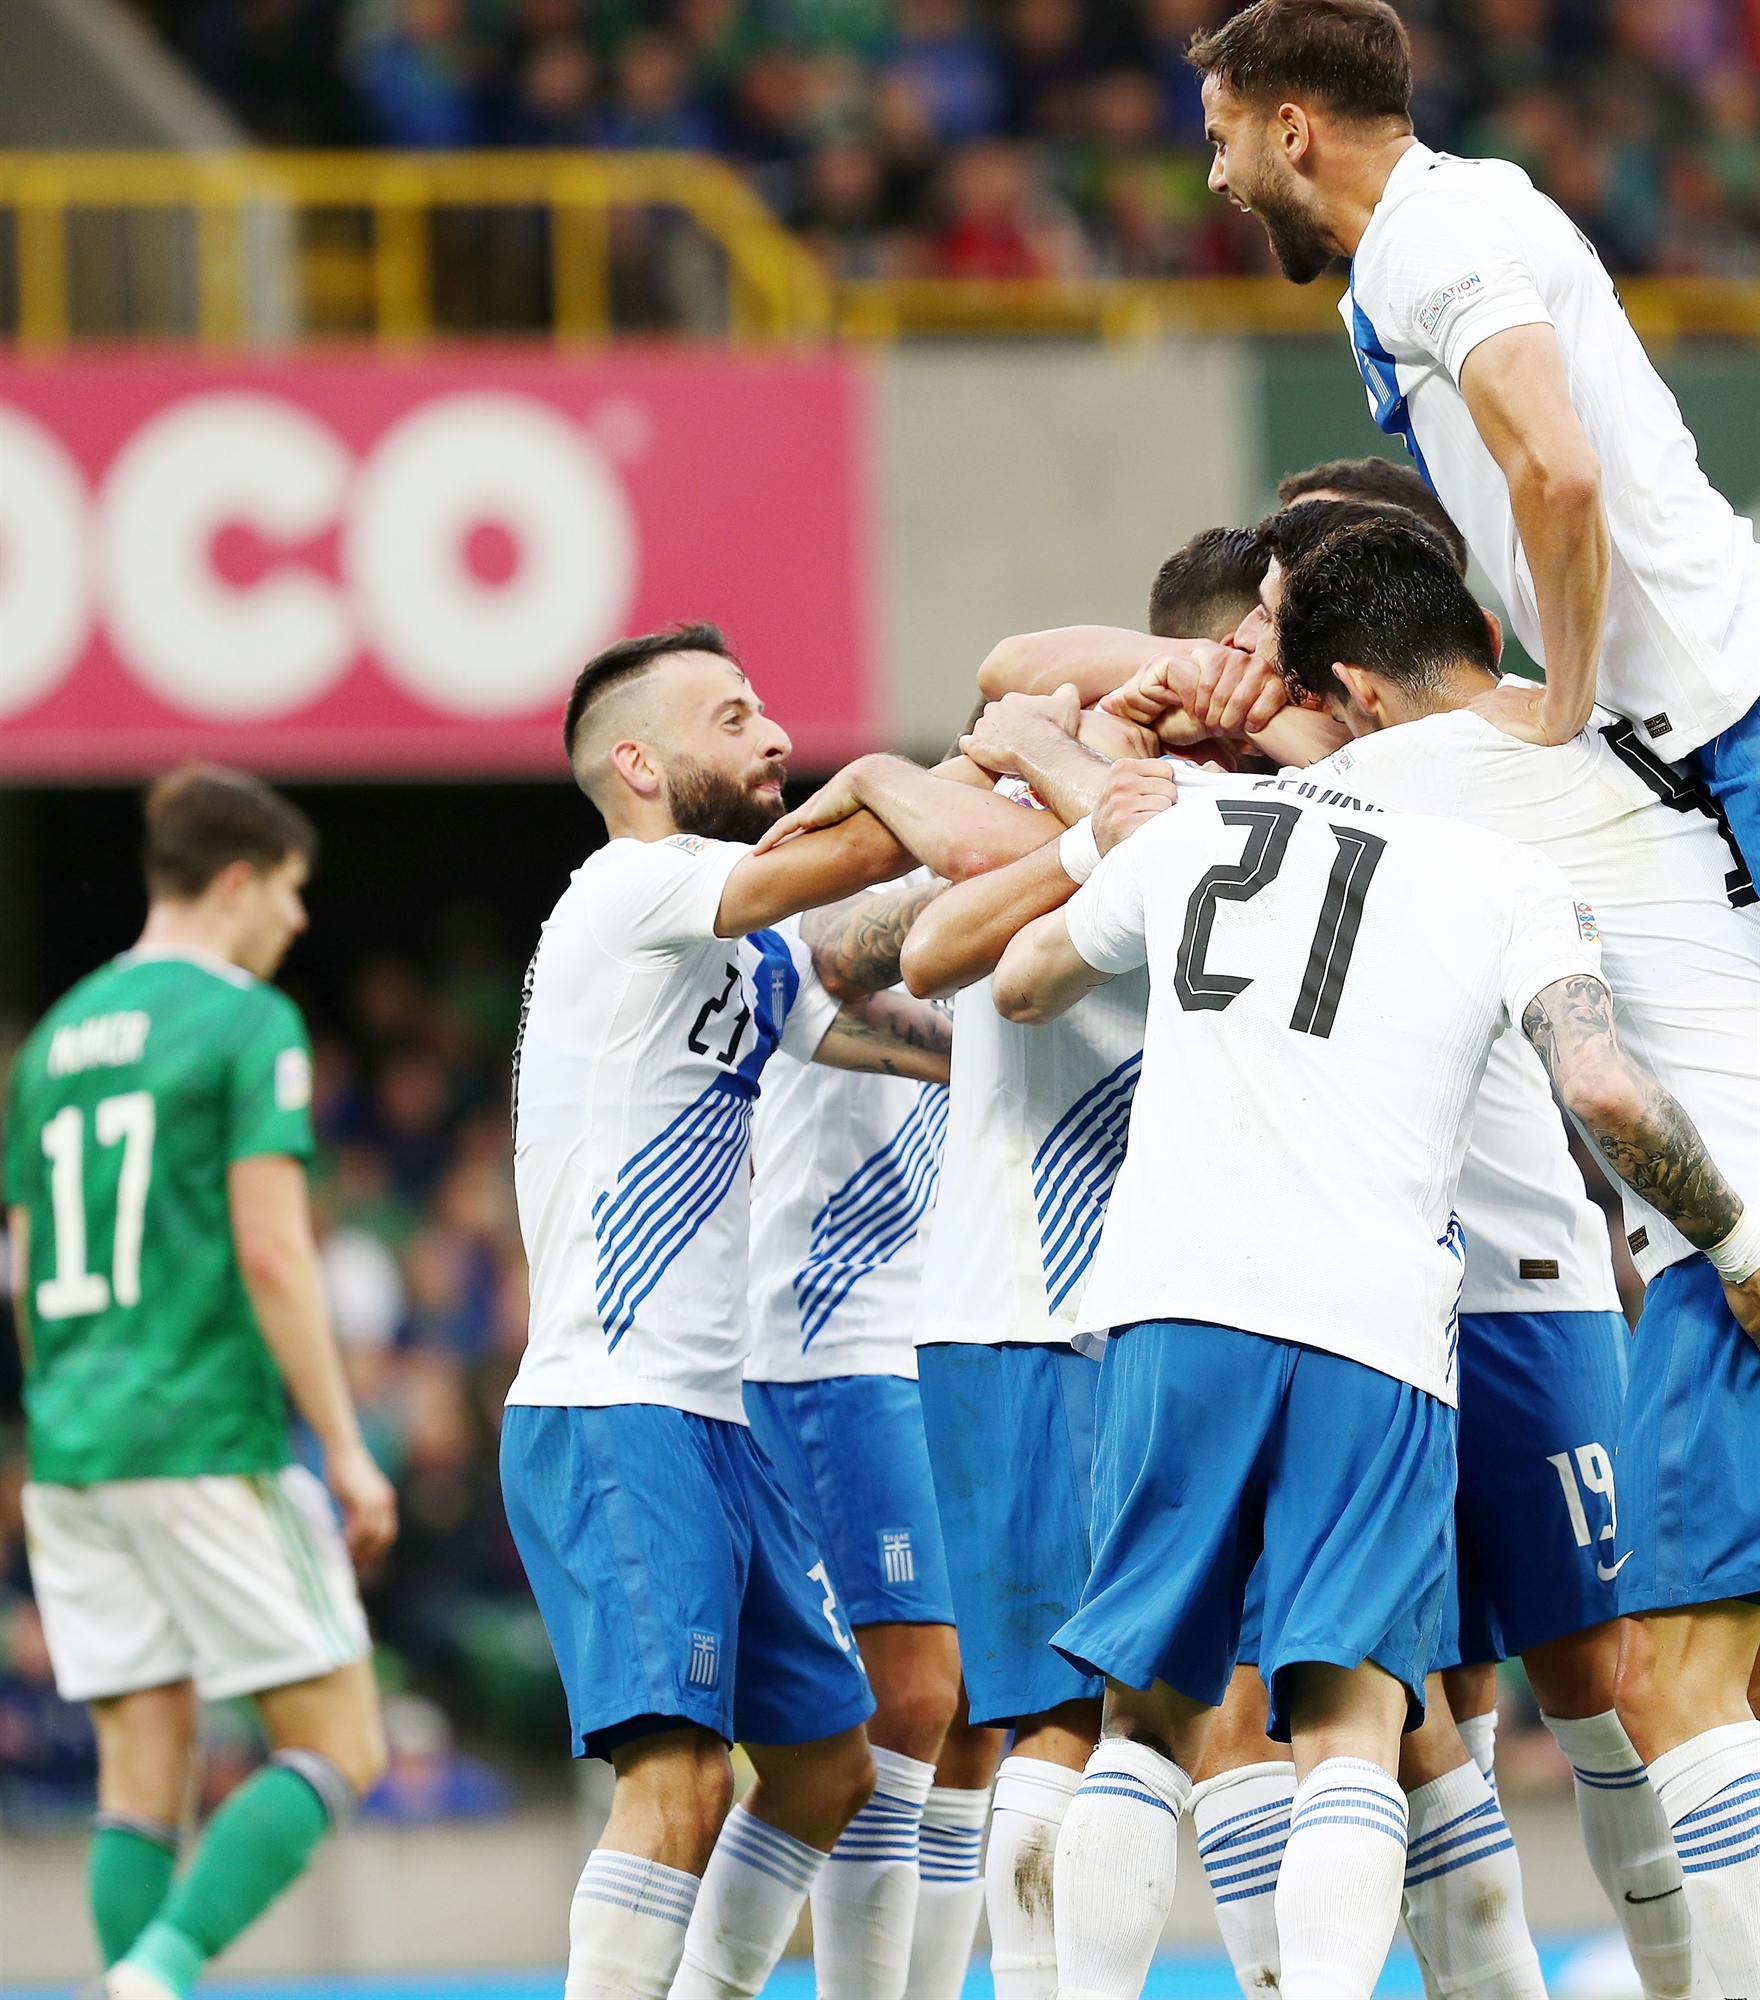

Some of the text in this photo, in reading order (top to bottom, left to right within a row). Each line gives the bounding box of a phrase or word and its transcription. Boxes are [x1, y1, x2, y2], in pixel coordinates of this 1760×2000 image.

[1422, 274, 1481, 332] FOUNDATION
[1174, 799, 1388, 1039] 21
[36, 1090, 155, 1320] 17
[1546, 1442, 1618, 1547] 19
[806, 1559, 866, 1675] 2
